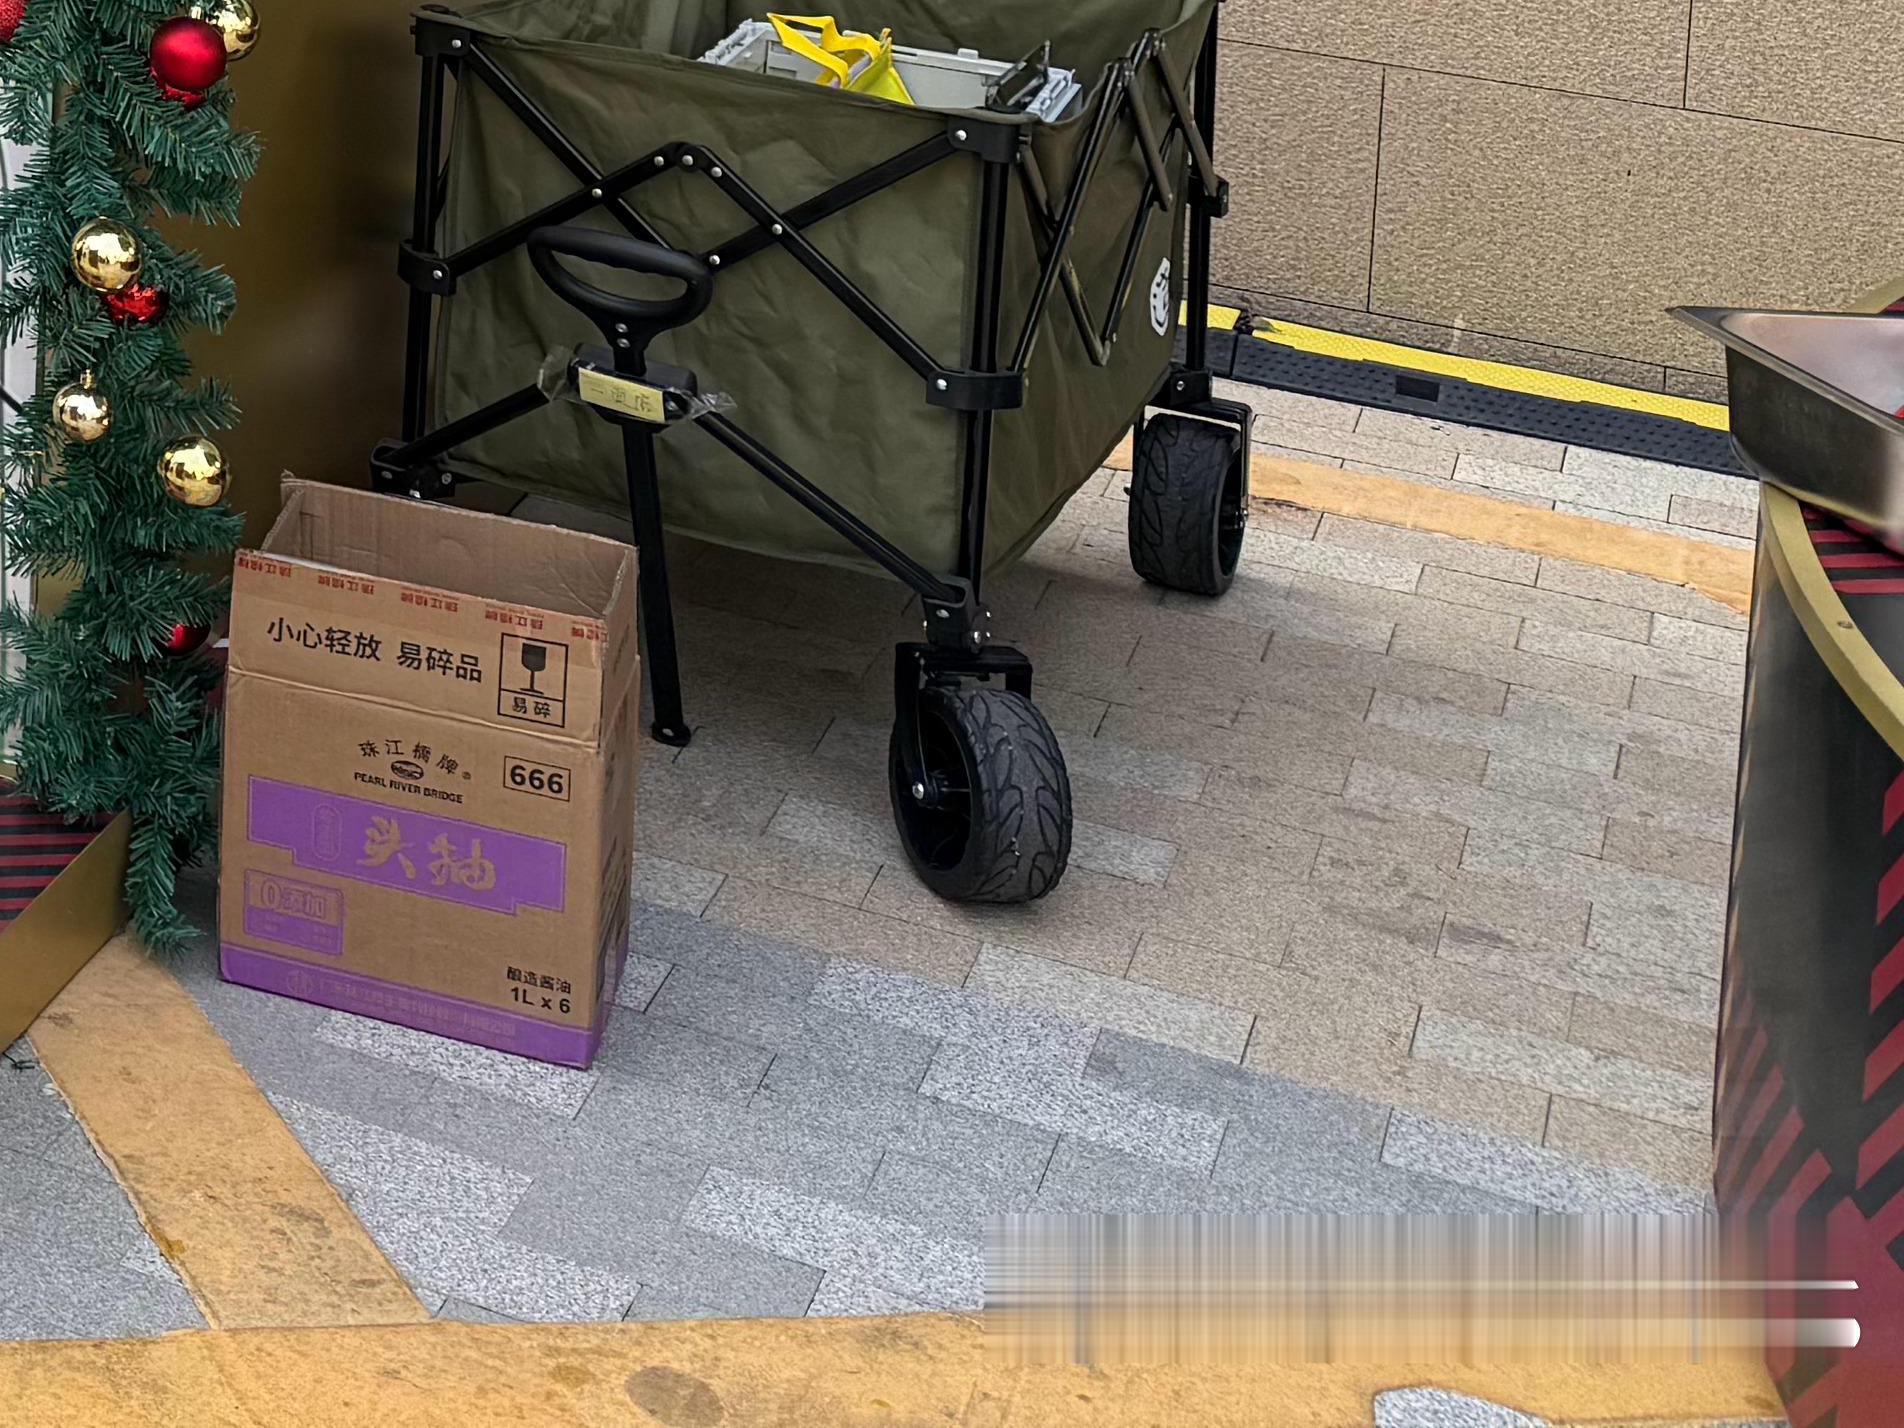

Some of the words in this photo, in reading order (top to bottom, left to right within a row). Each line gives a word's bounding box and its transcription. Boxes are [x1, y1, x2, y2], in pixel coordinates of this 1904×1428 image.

[266, 616, 383, 662] 小心轻放
[396, 640, 482, 683] 易碎品
[511, 696, 552, 719] 易碎
[354, 771, 387, 788] PEARL
[389, 779, 422, 796] RIVER
[423, 787, 464, 804] BRIDGE
[509, 763, 565, 794] 666
[511, 987, 535, 1005] 1L
[559, 998, 571, 1015] 6
